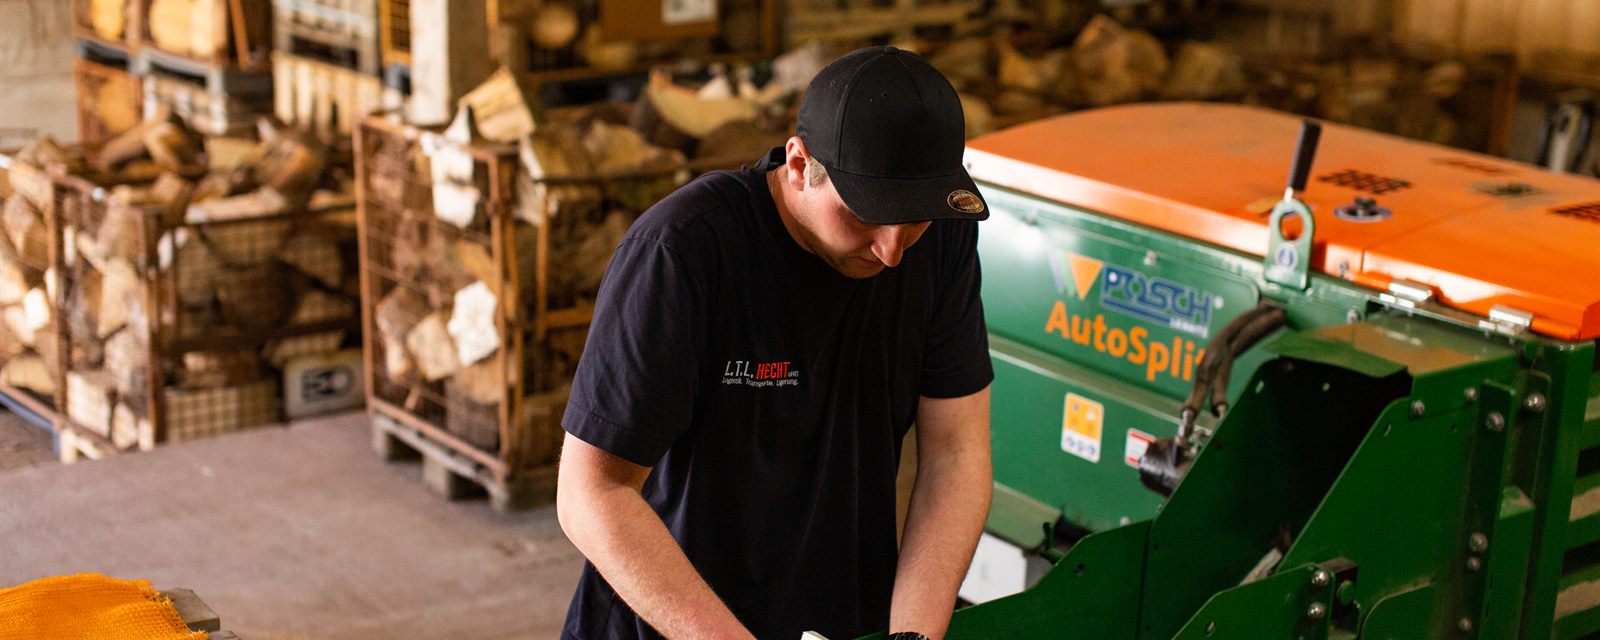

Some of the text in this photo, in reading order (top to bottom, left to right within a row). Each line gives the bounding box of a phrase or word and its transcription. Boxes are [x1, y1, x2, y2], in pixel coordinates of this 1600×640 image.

[1103, 266, 1211, 323] POSCH
[1045, 300, 1206, 381] AutoSpli
[724, 360, 753, 378] L.T.L.
[755, 361, 791, 379] HECHT
